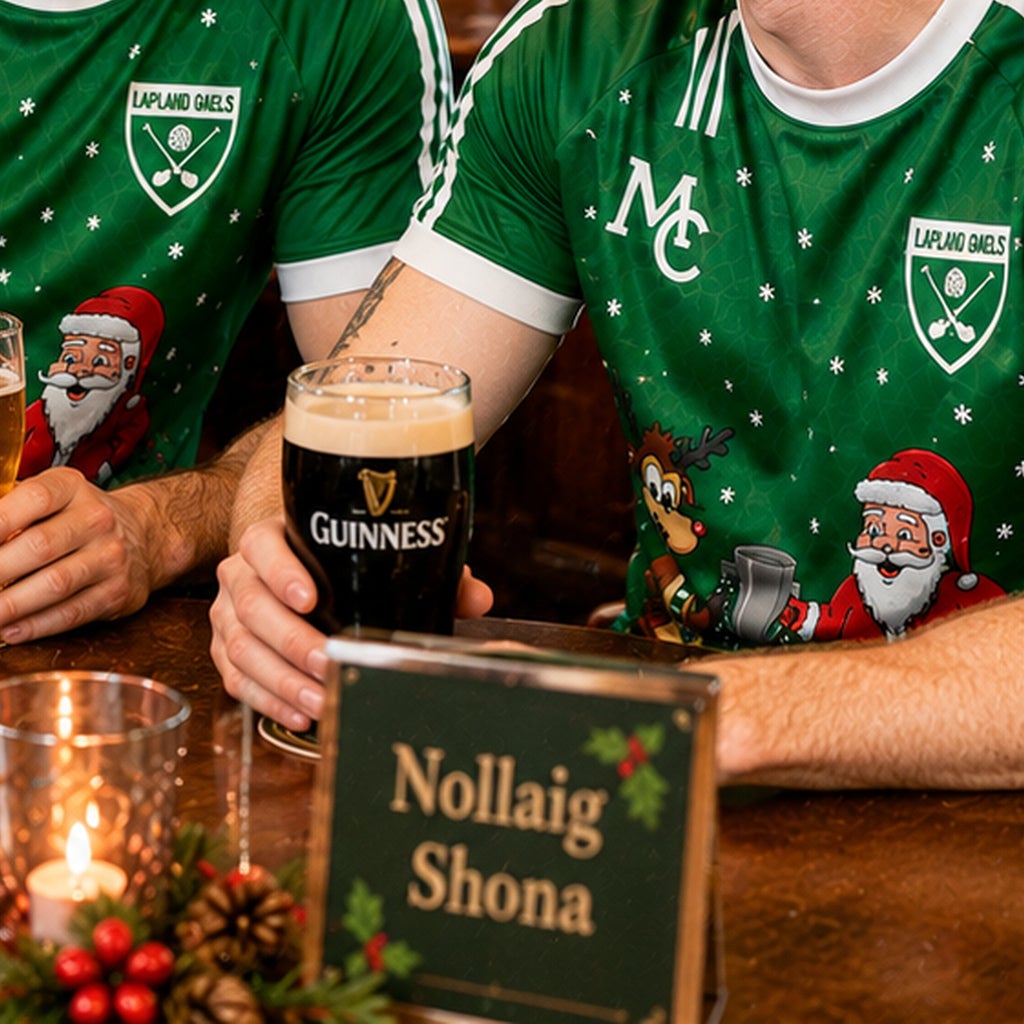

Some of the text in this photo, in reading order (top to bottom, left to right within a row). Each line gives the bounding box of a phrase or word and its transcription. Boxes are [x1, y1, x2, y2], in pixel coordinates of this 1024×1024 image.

[132, 90, 235, 113] LAPLAND GAELS
[310, 510, 446, 551] GUINNESS
[389, 742, 609, 860] Nollaig
[407, 841, 596, 936] Shona
